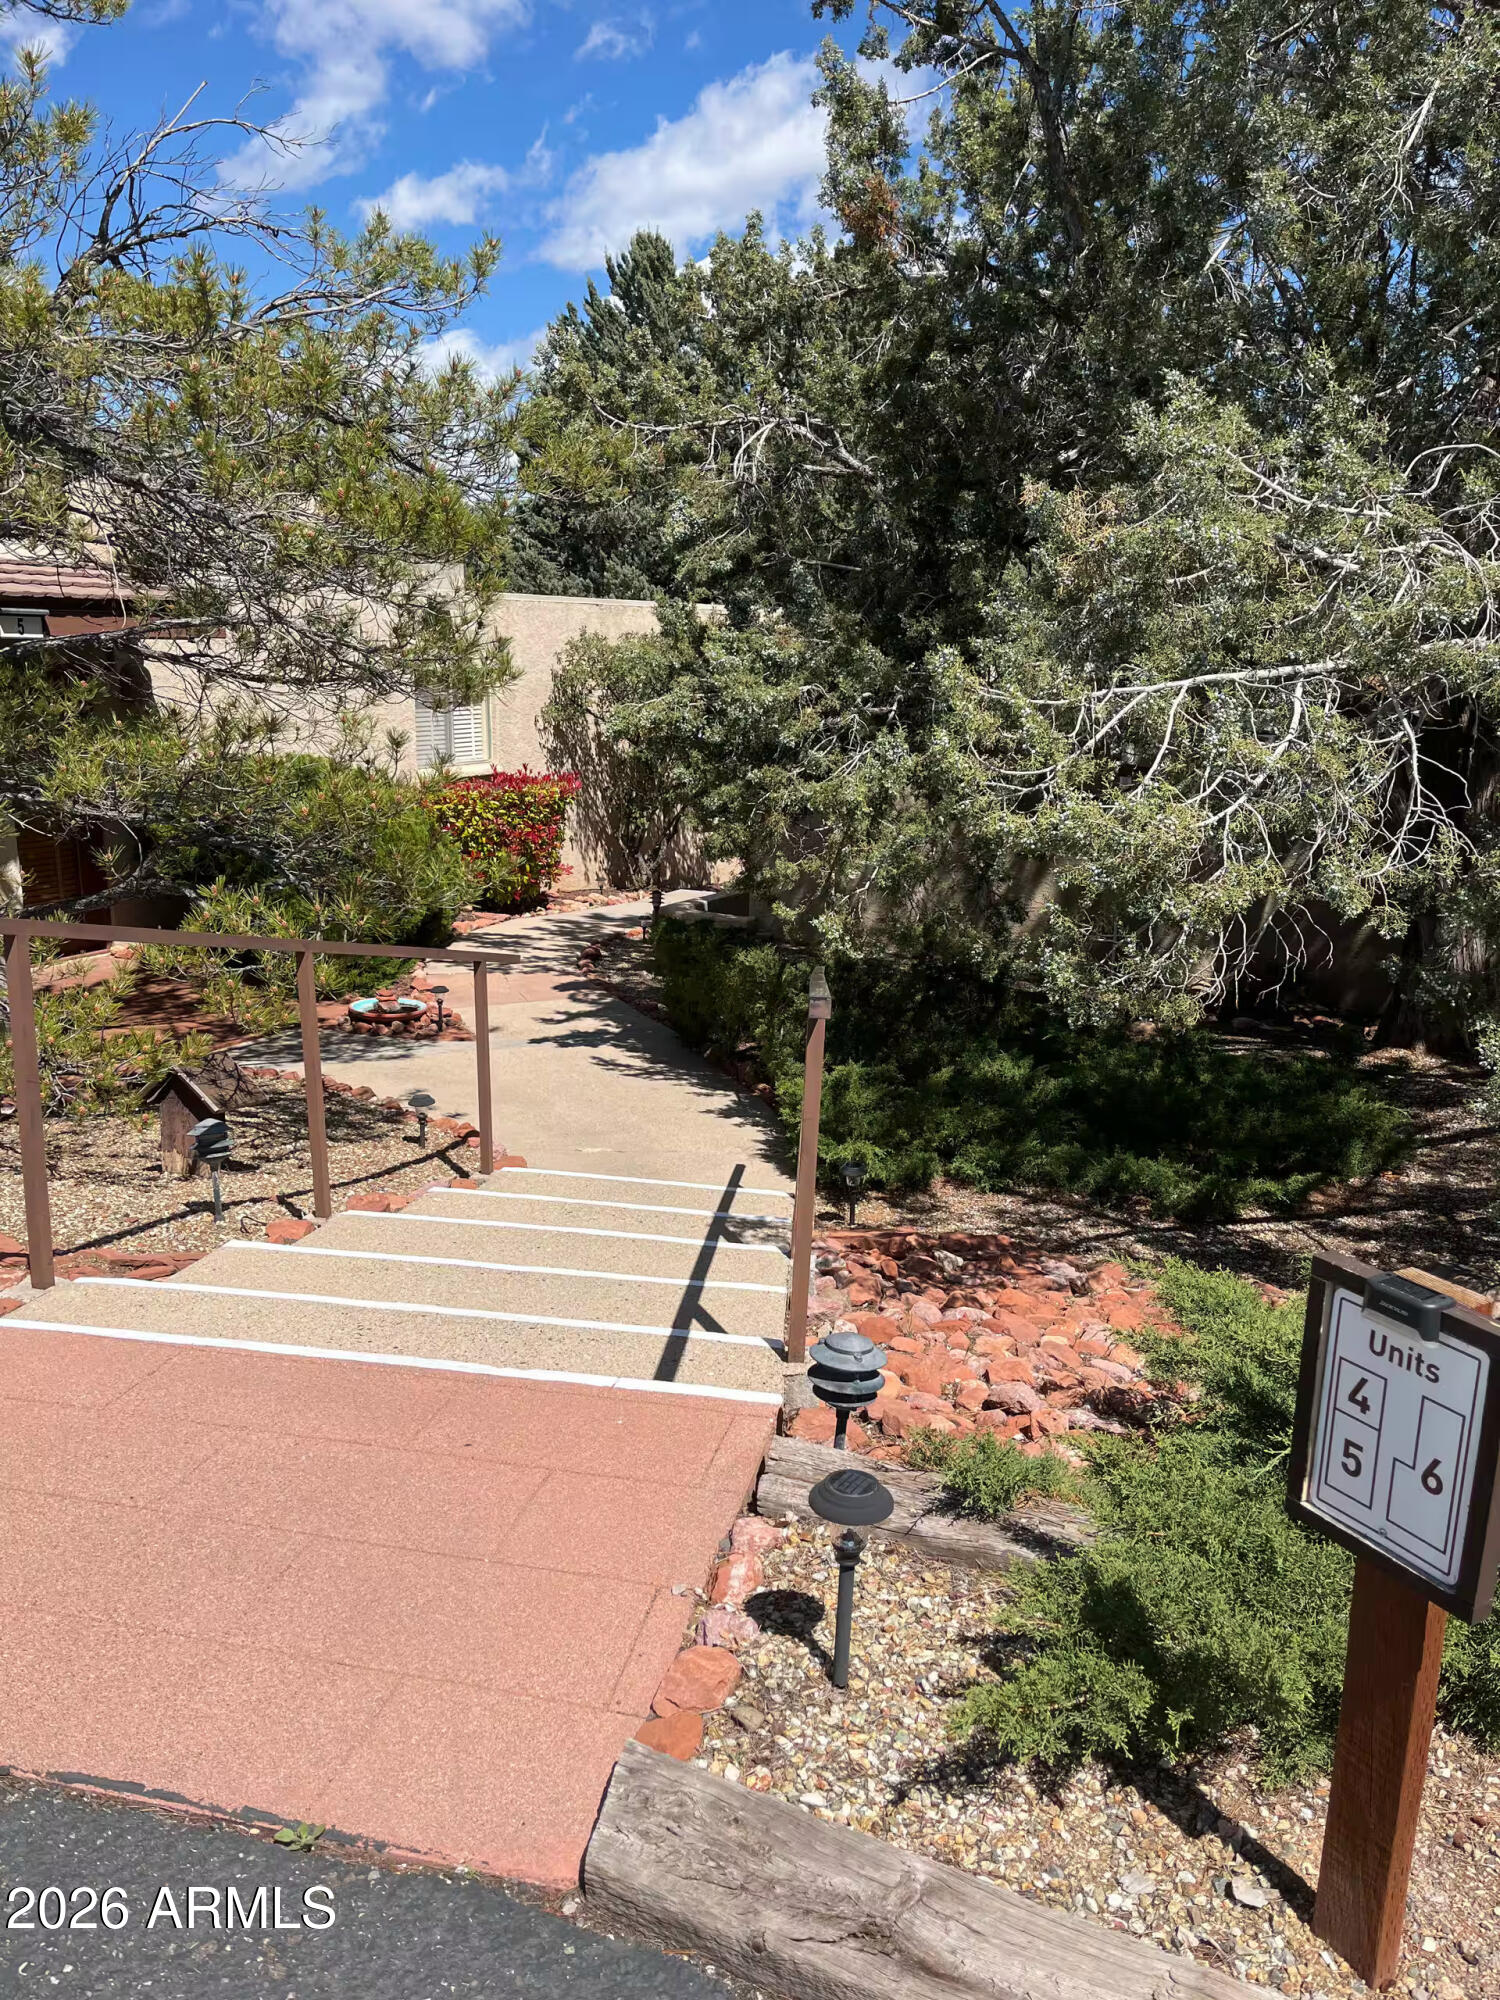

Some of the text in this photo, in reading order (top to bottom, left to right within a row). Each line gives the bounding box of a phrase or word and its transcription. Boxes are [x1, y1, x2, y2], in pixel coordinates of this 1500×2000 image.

[17, 617, 25, 636] 5
[1368, 1329, 1441, 1384] Units
[1347, 1376, 1371, 1415] 4
[1341, 1437, 1364, 1478] 5
[1420, 1457, 1444, 1496] 6
